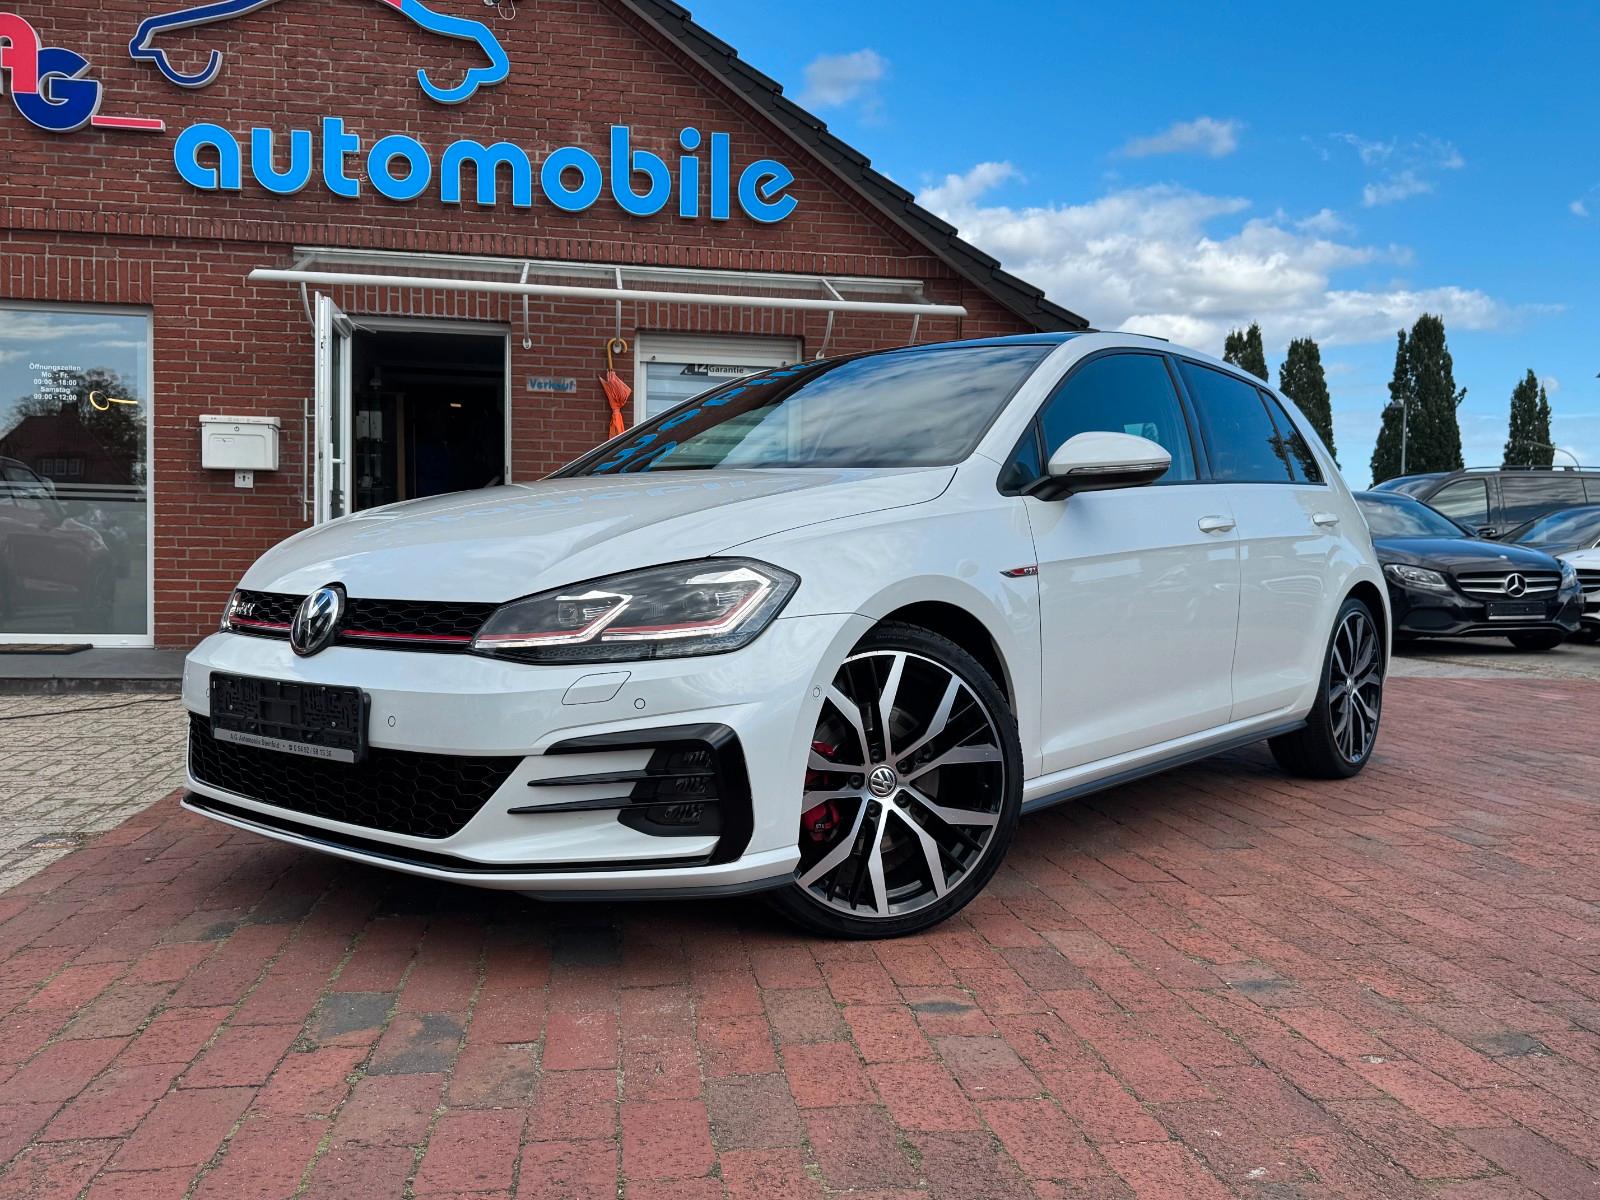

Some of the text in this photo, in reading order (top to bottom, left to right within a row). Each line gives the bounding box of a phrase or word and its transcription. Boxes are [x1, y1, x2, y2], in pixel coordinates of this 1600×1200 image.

[174, 116, 798, 223] automobile
[29, 363, 81, 371] Öffnungszeiten
[708, 365, 744, 374] Garantie
[40, 386, 71, 394] Samstag
